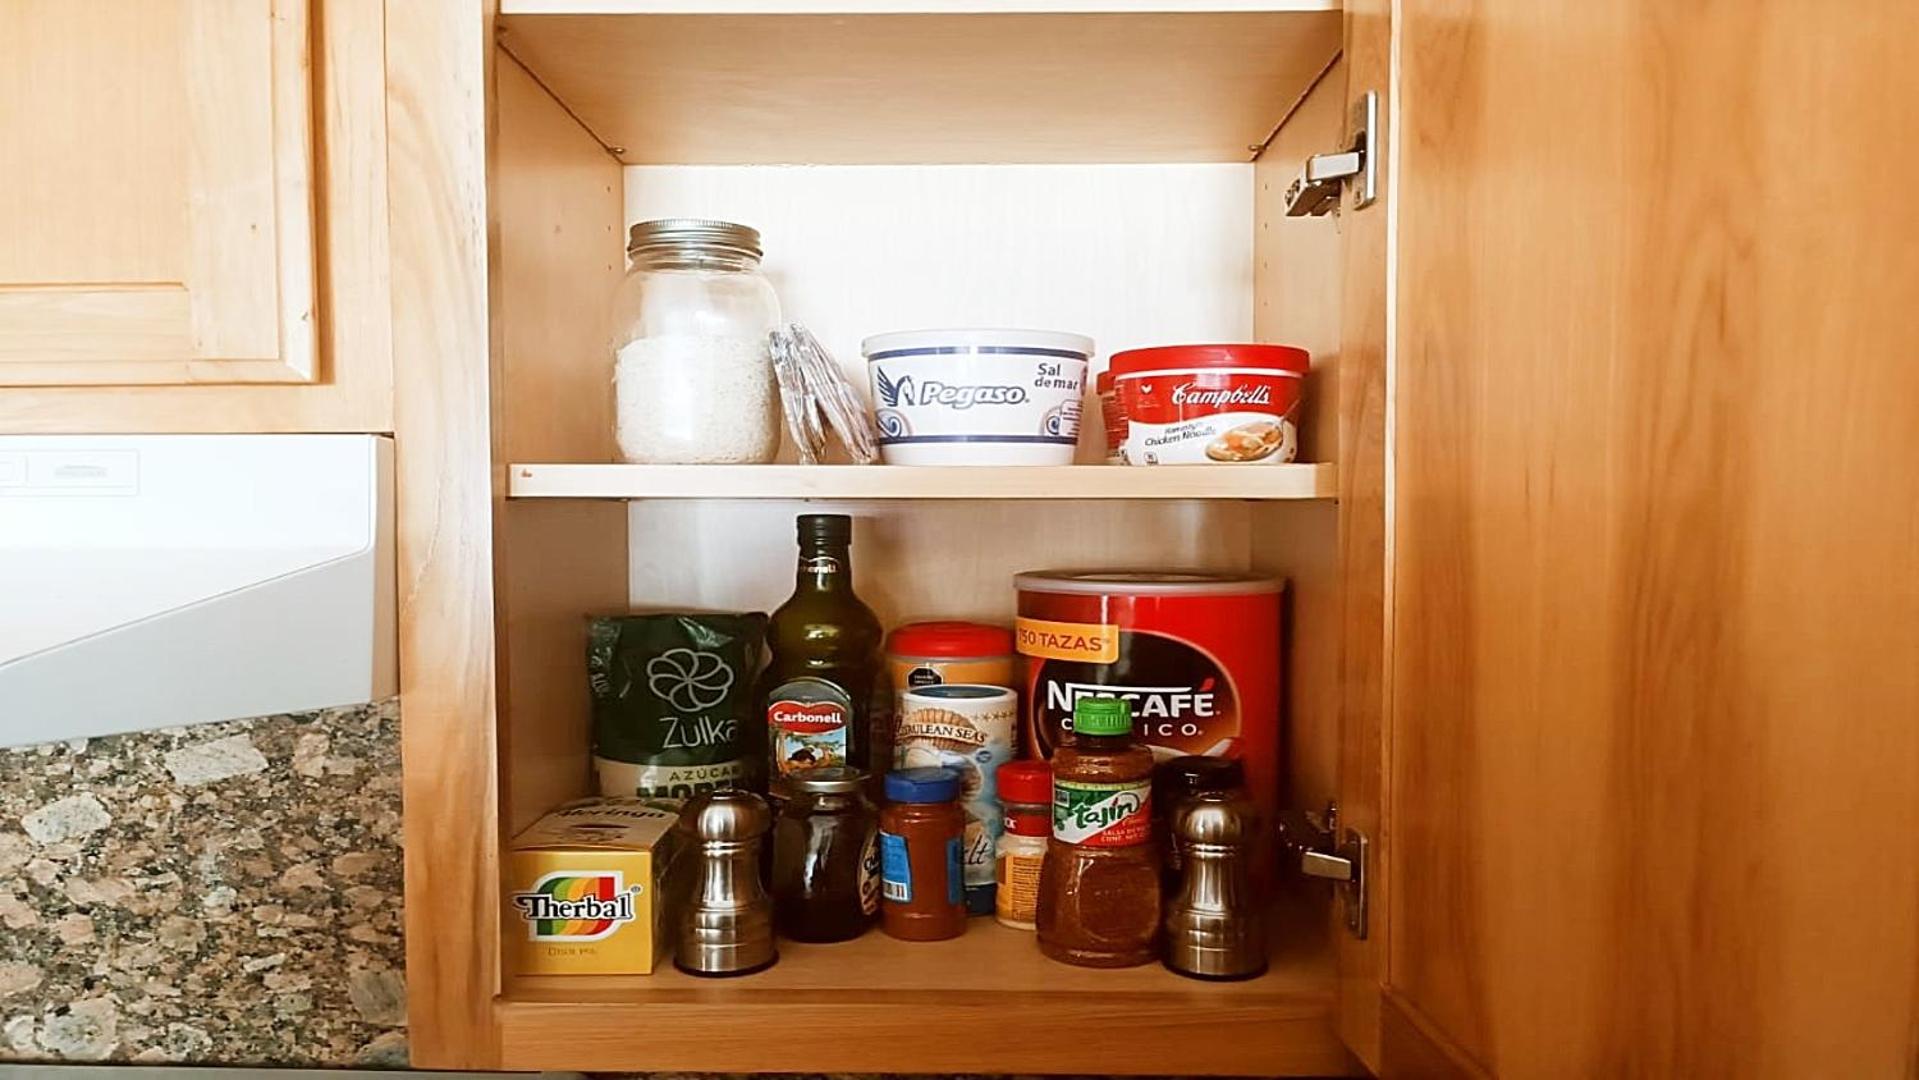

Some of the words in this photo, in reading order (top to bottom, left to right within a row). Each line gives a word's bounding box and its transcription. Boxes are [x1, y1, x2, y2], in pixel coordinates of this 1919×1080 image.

[1037, 362, 1061, 377] Sal
[1034, 376, 1052, 388] de
[1053, 379, 1078, 390] mar
[919, 381, 1026, 410] Pegaso
[1039, 631, 1103, 652] TAZAS
[1048, 677, 1214, 718] NCAFÉ
[773, 710, 843, 724] Carbonell
[659, 715, 738, 749] Zulka
[899, 723, 953, 738] RULEAN
[1061, 718, 1197, 737] CICO
[515, 893, 630, 919] Therbal
